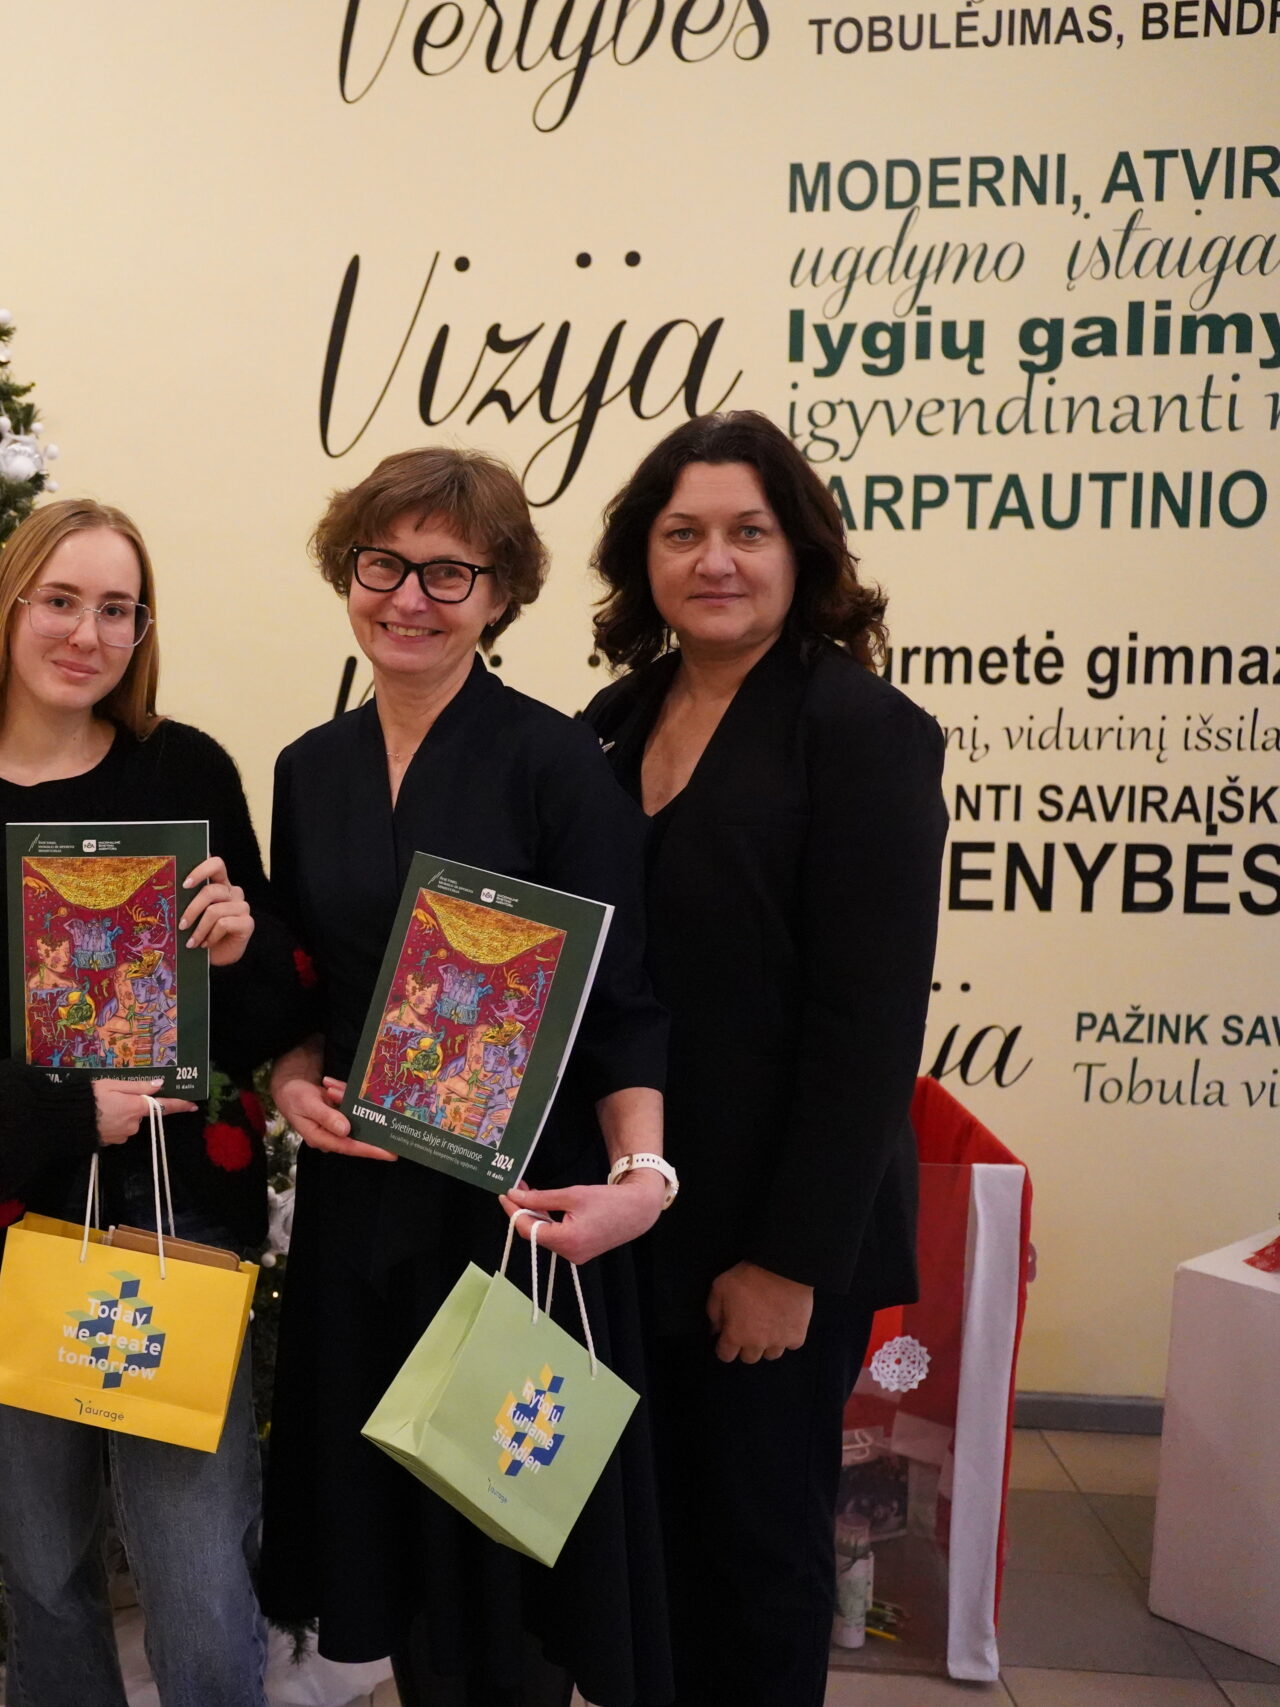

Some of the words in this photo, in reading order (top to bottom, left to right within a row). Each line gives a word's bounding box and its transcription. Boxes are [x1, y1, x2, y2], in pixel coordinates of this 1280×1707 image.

[808, 0, 1124, 55] TOBULĖJIMAS,
[789, 153, 1082, 215] MODERNI,
[790, 206, 1025, 320] ugdymo
[788, 306, 985, 378] lygių
[320, 251, 743, 508] Vizija
[1001, 707, 1170, 763] vidurinį
[1075, 1005, 1210, 1046] PAŽINK
[175, 1066, 198, 1079] 2024
[1073, 1057, 1229, 1107] Tobula
[352, 1105, 388, 1126] LIETUVA.
[391, 1118, 422, 1139] Švietimas
[447, 1141, 483, 1163] regionuose
[491, 1152, 515, 1172] 2024
[63, 1324, 90, 1341] we
[95, 1331, 161, 1355] create
[88, 1298, 148, 1328] Today
[58, 1345, 157, 1380] tomorrow
